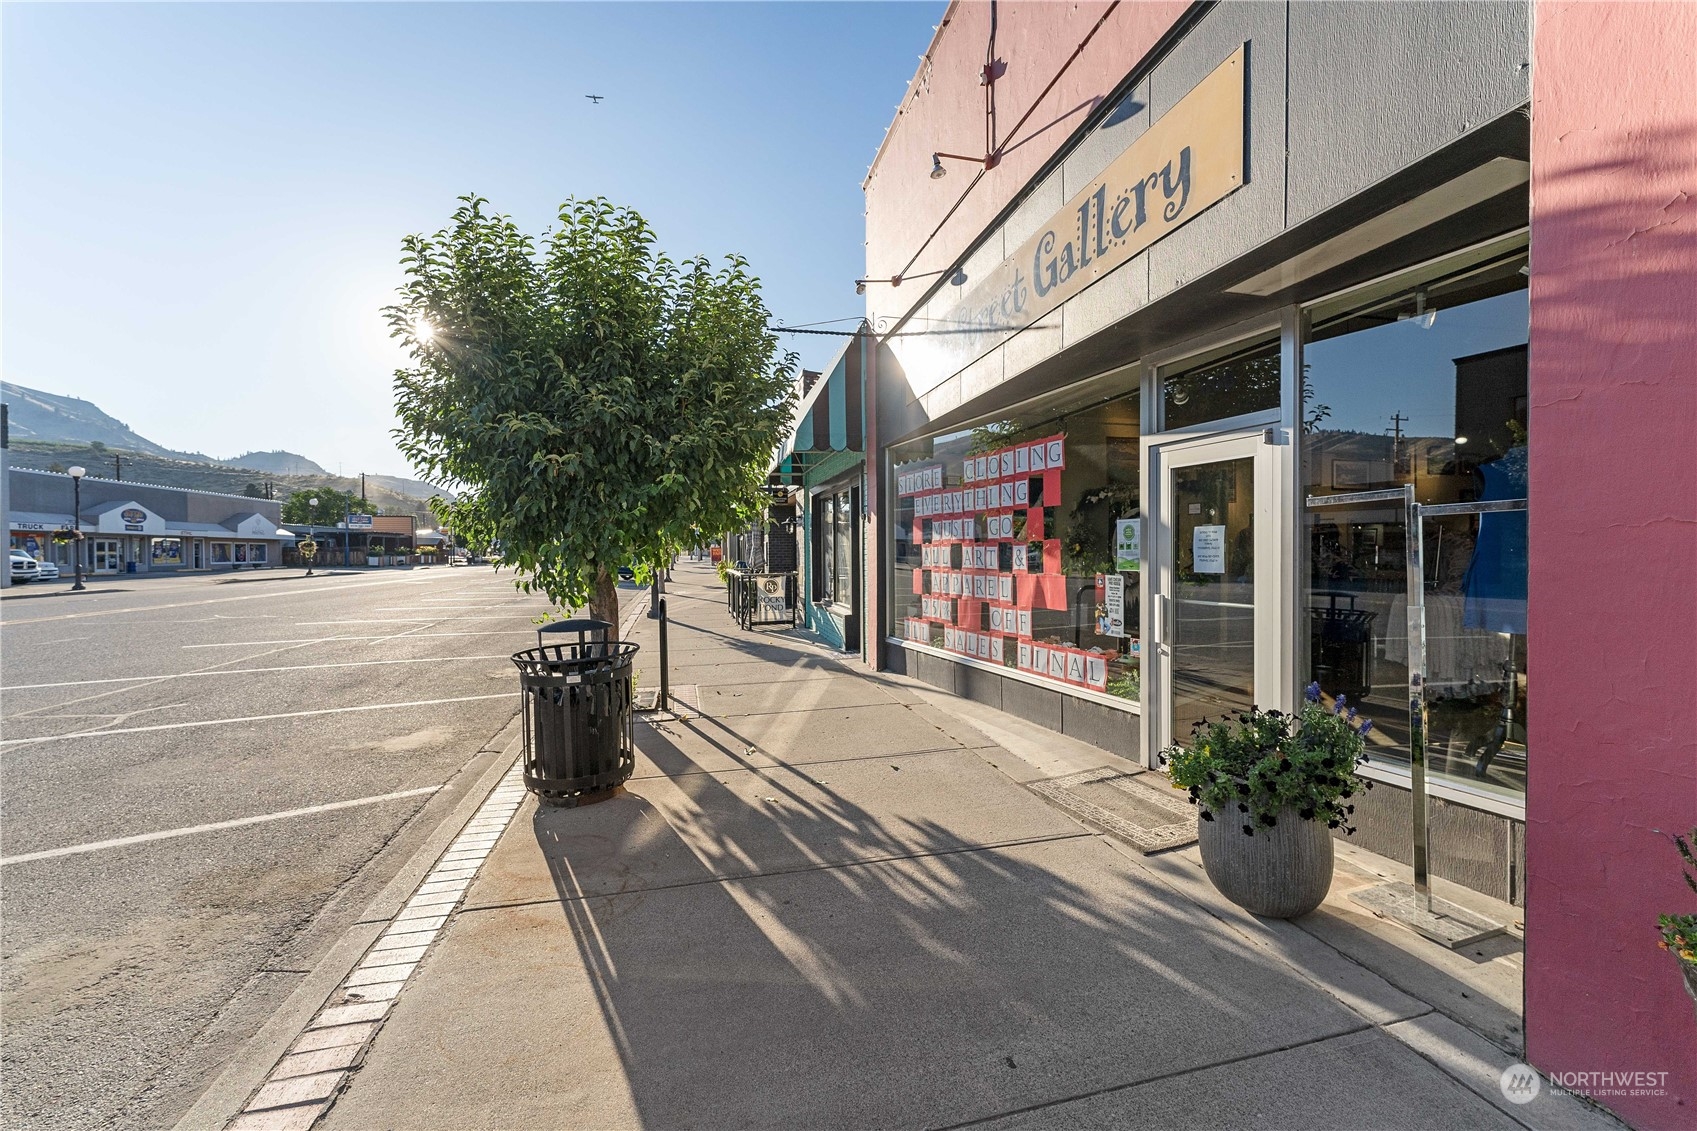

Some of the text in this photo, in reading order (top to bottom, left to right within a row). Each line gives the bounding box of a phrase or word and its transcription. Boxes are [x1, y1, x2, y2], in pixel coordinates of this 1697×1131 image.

[1032, 145, 1191, 298] Gallery
[898, 442, 1061, 493] STORE CLOSING
[915, 482, 1027, 513] EVERYTHING
[932, 517, 1012, 538] MUST GO
[923, 549, 1025, 567] ALL ART &
[758, 596, 785, 604] ROCKY
[933, 577, 1011, 598] APPAREL
[923, 599, 1027, 632] 25% OFF
[904, 620, 1101, 682] ALL SALES FINAL
